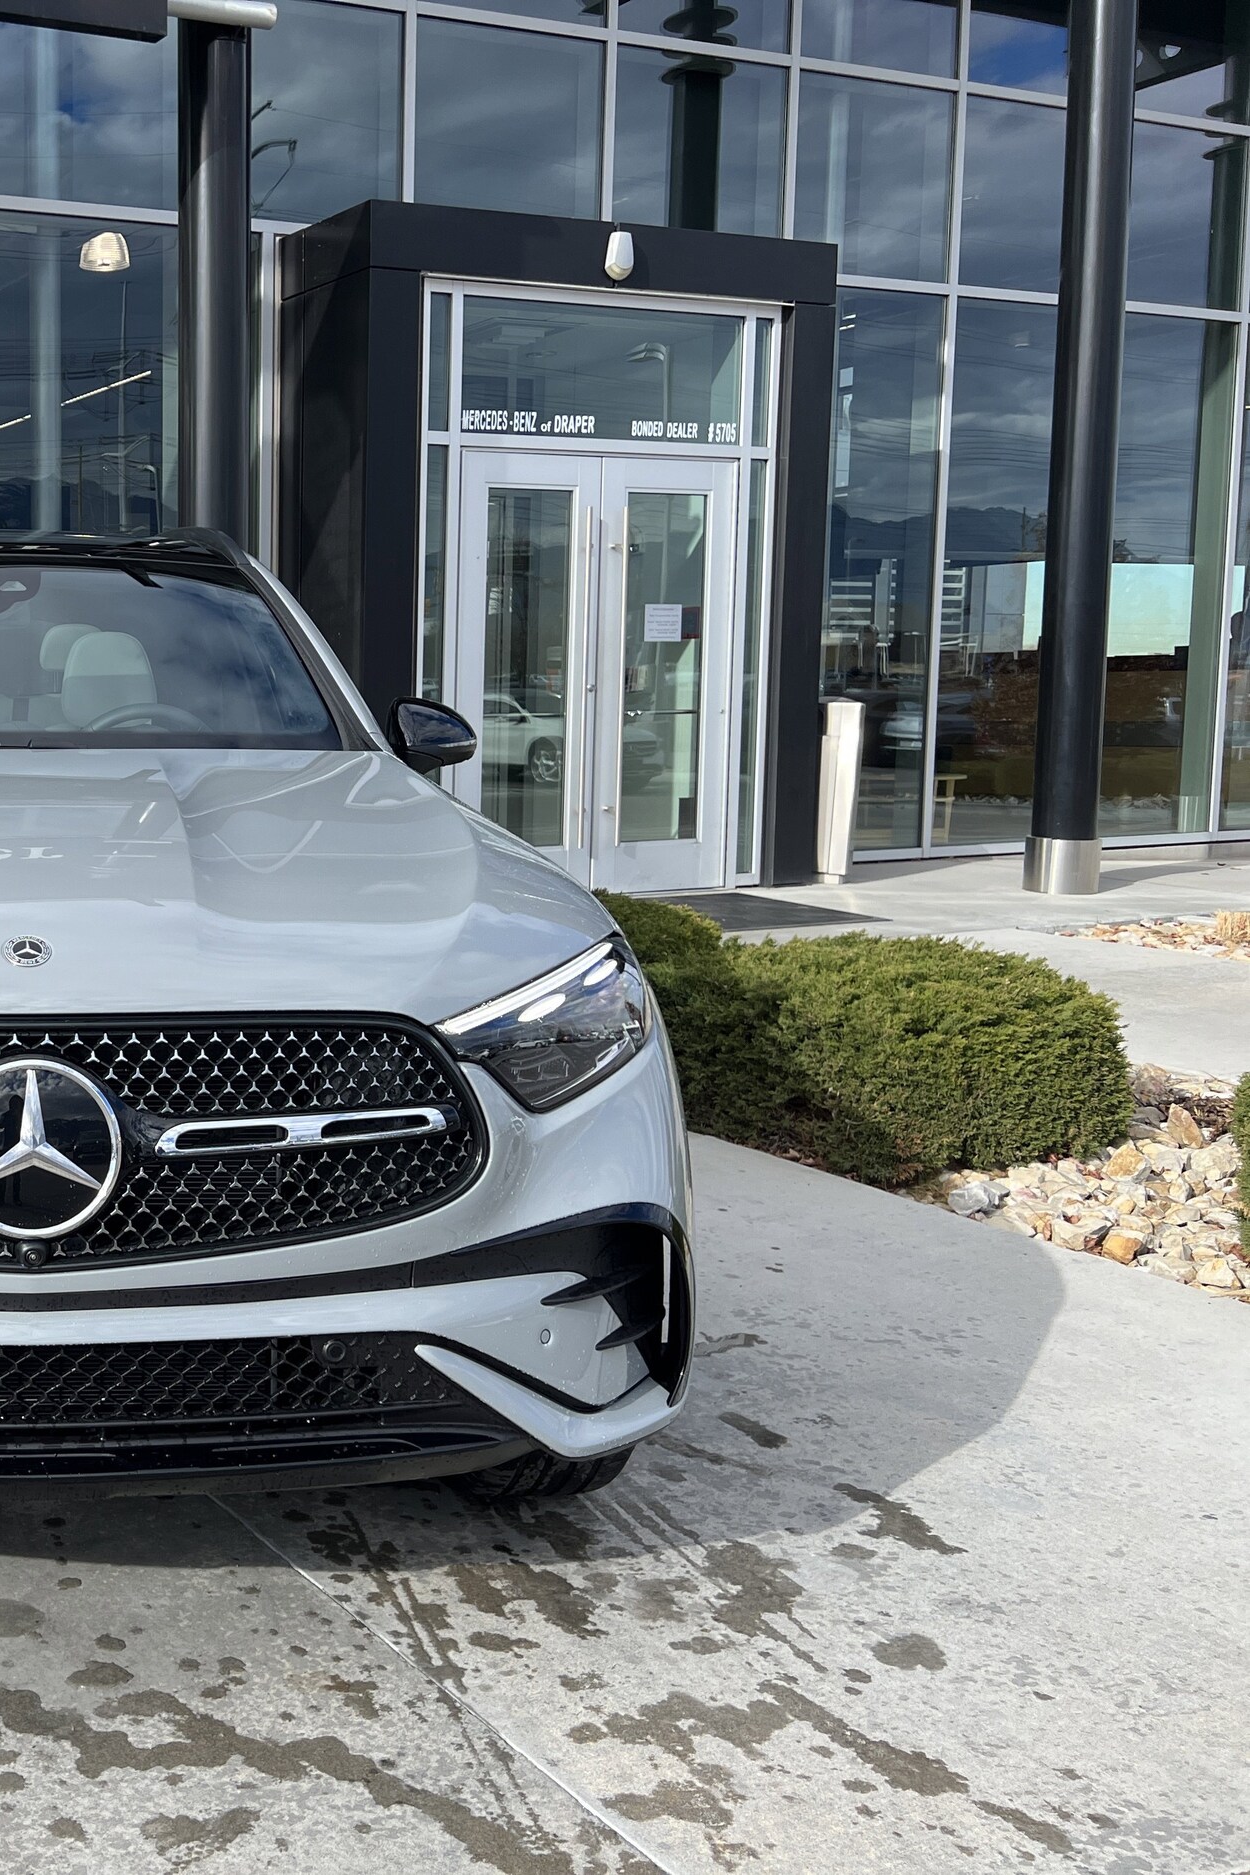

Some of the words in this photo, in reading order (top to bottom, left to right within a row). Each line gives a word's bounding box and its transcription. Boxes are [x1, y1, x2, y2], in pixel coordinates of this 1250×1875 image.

[461, 410, 537, 432] MERCEDES-BENZ
[540, 421, 551, 432] of
[554, 415, 595, 434] DRAPER
[631, 420, 664, 437] BONDED
[666, 422, 698, 439] DEALER
